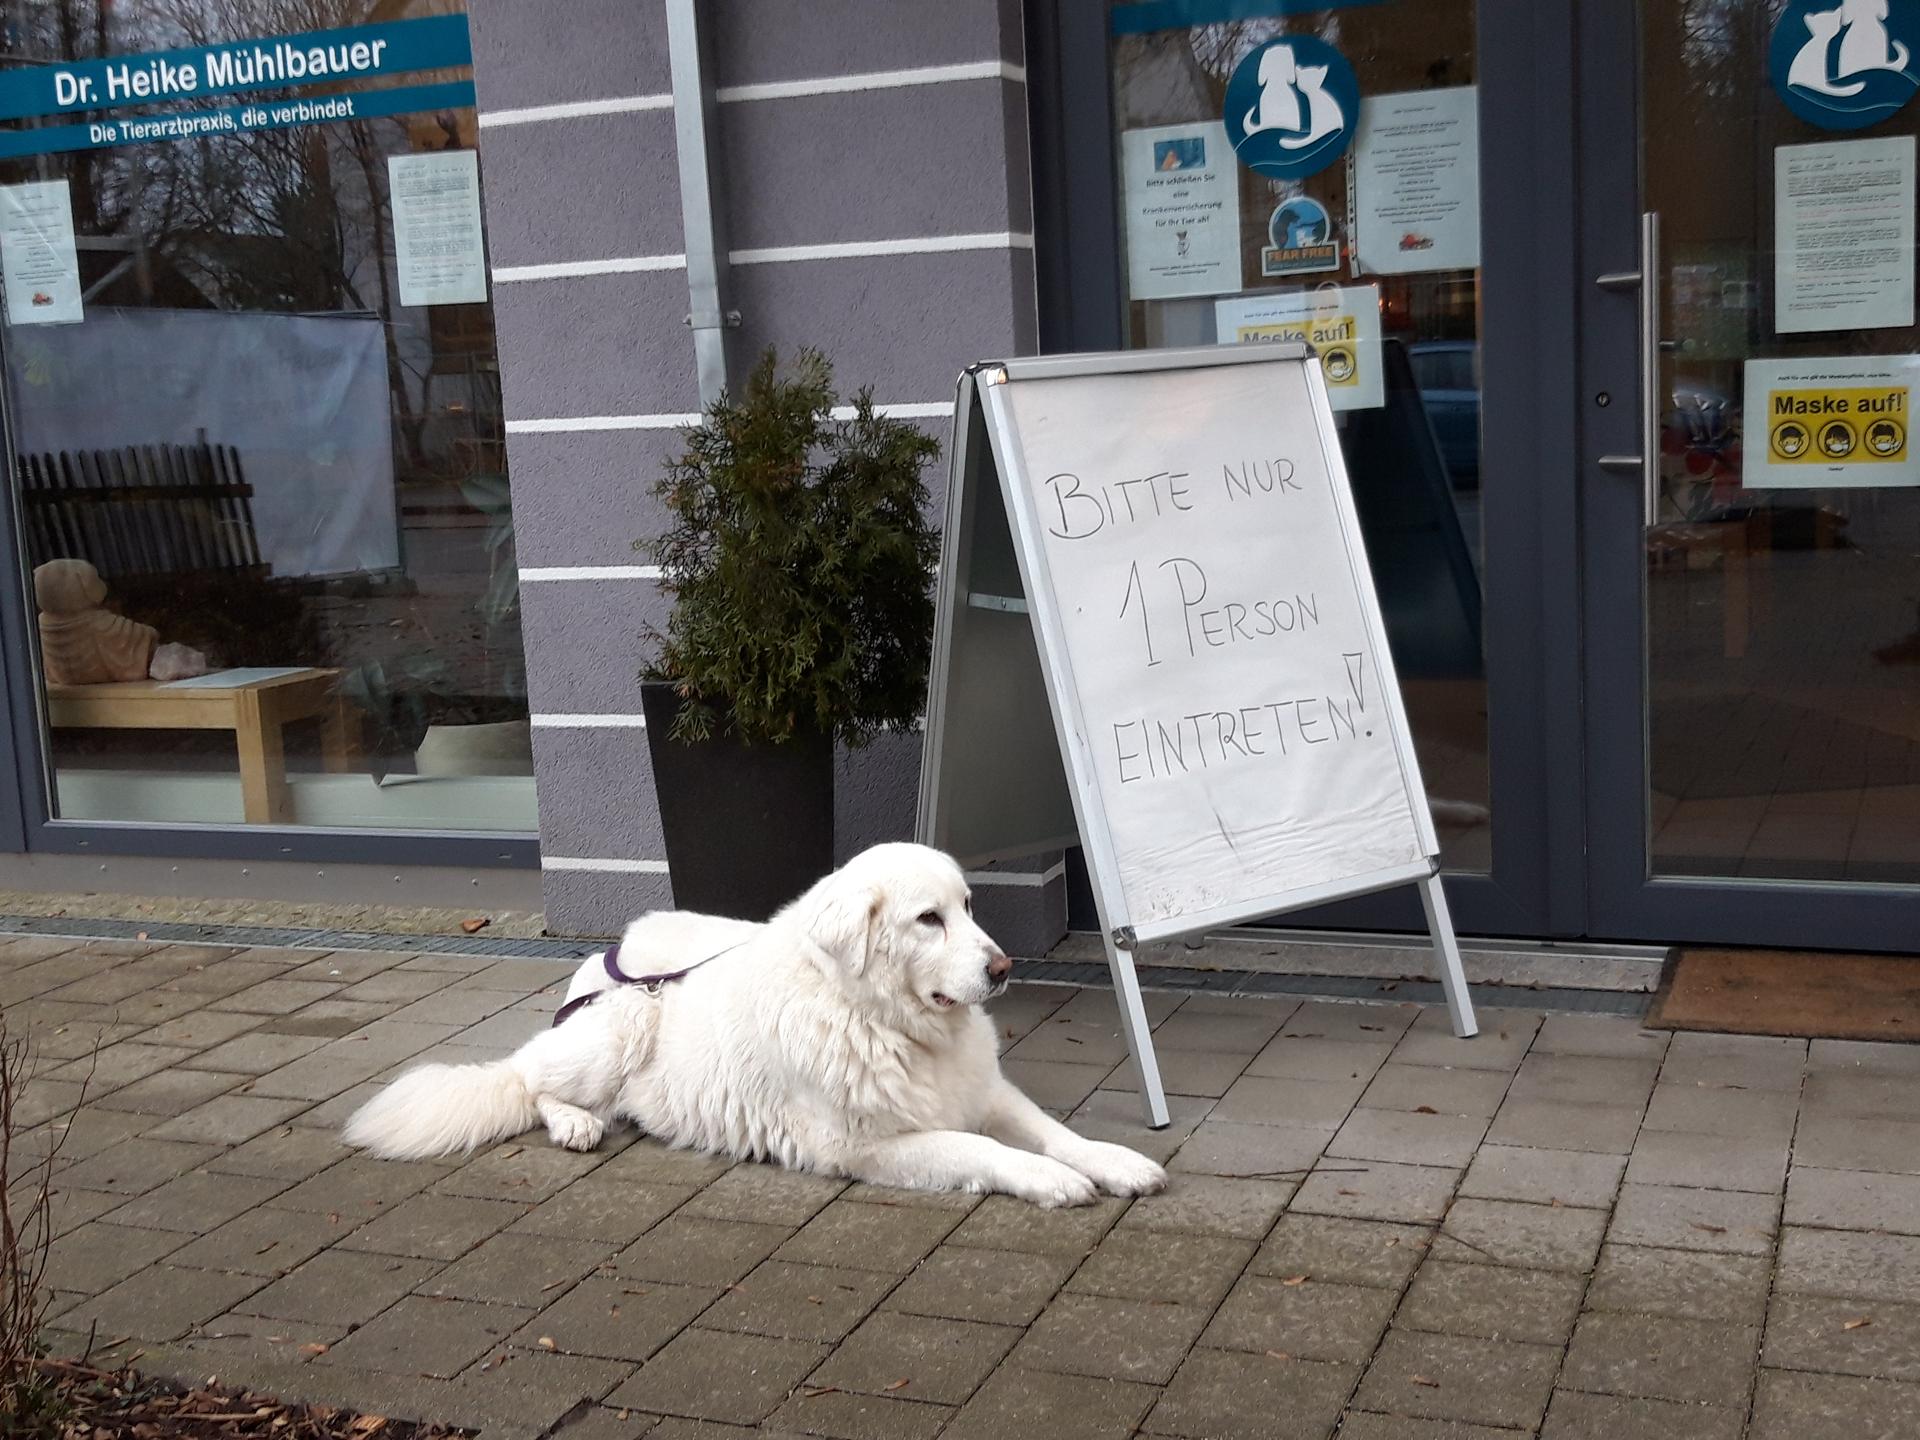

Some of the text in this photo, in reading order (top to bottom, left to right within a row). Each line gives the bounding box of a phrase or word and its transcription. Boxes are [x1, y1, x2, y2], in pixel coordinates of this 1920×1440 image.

[54, 39, 387, 106] Dr. Heike Mühlbauer
[90, 97, 355, 143] Die Tierarztpraxis, die verbindet
[1173, 191, 1189, 199] eine
[1313, 322, 1351, 343] auf!
[1775, 393, 1902, 415] Maske auf!
[1045, 457, 1303, 540] BITTE NUR
[1119, 556, 1320, 667] 1 PERSON
[1112, 652, 1373, 785] EINTRETEN!
